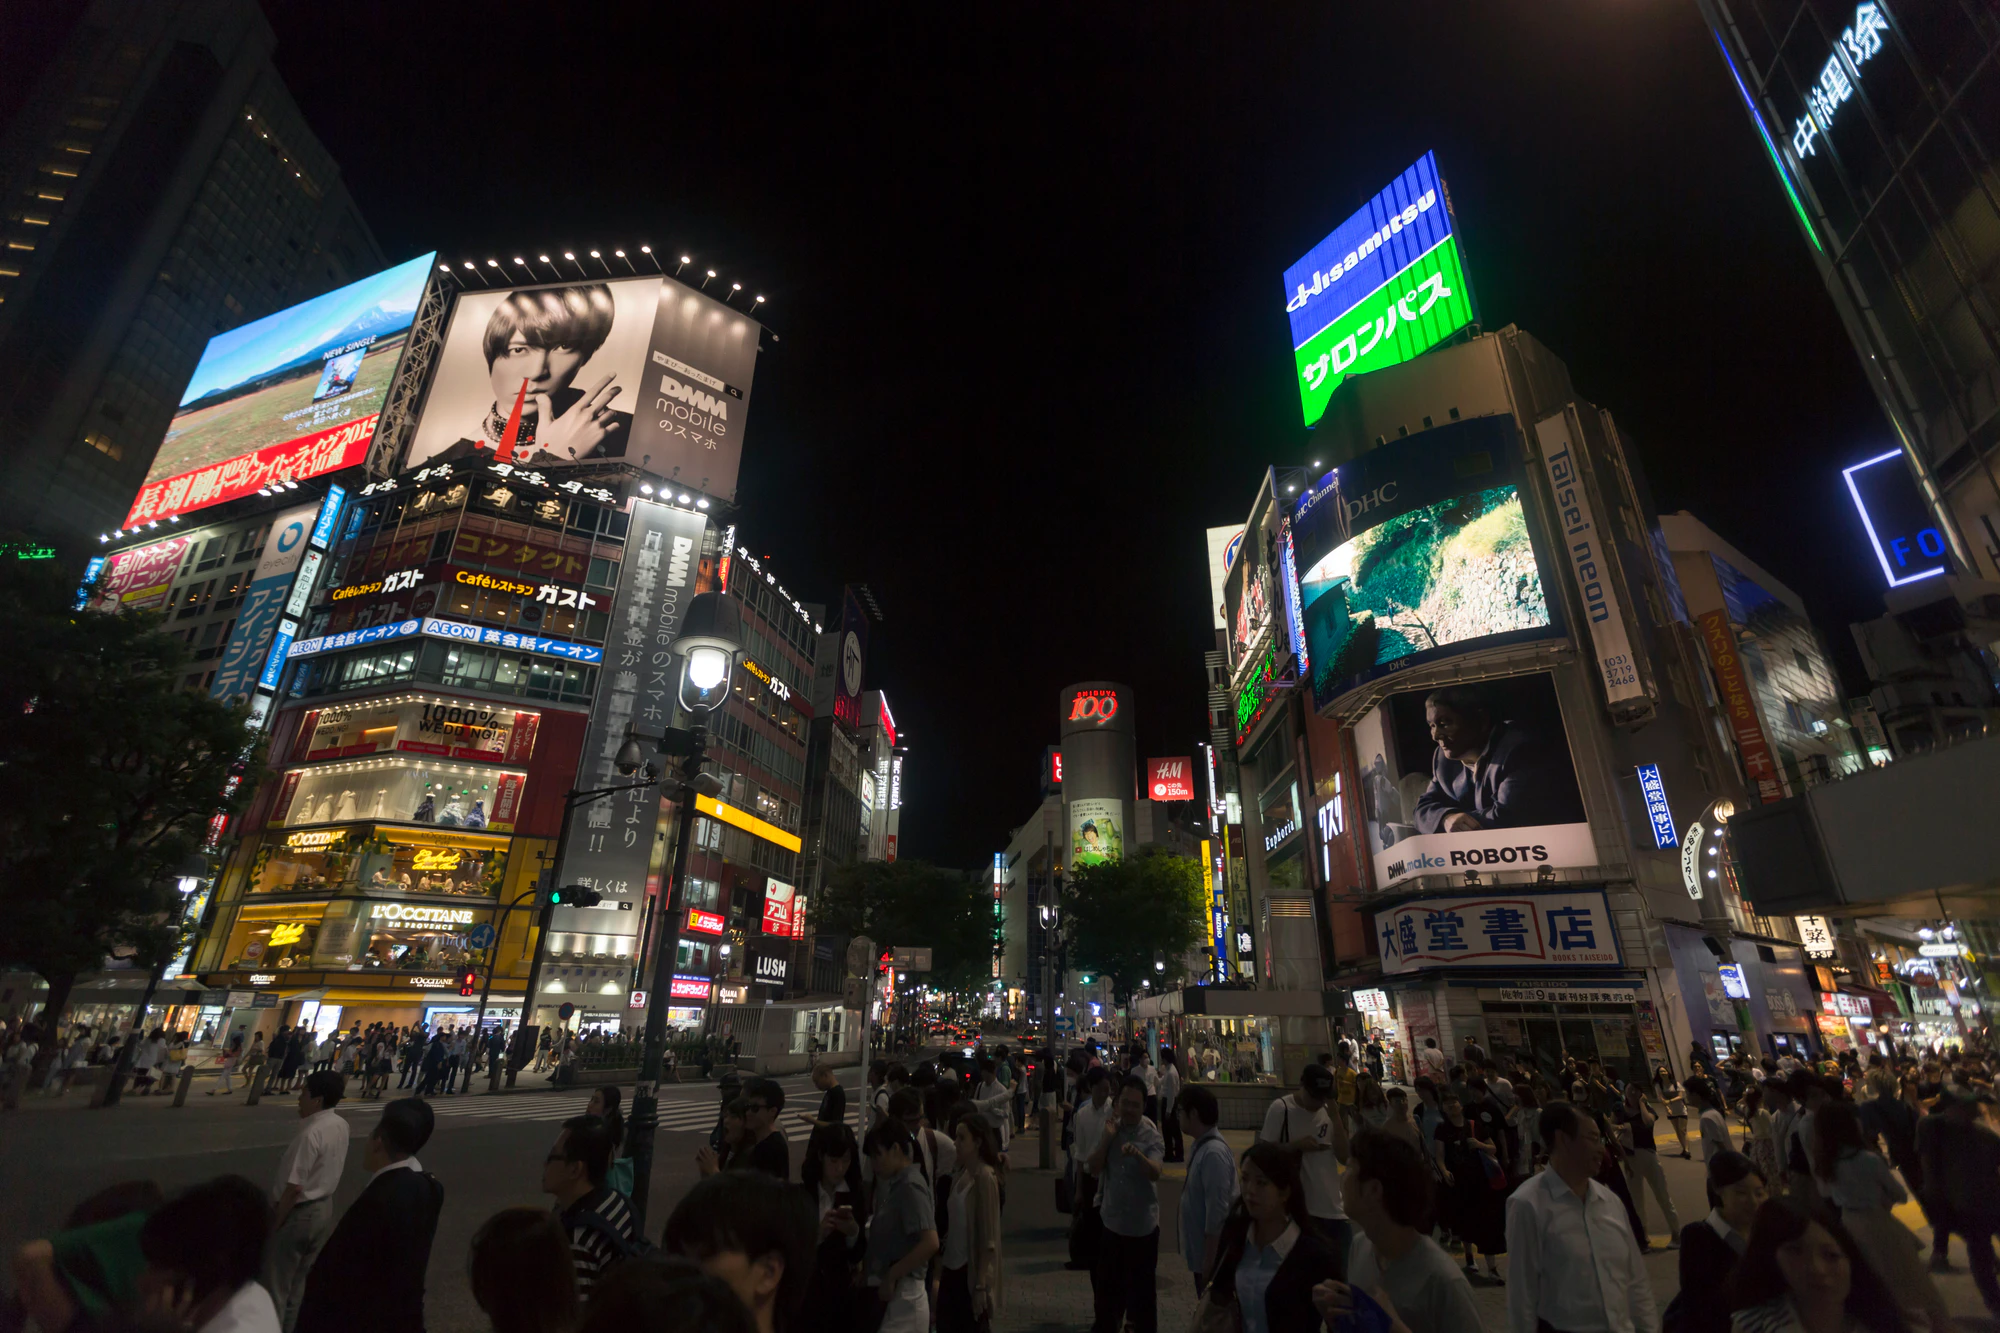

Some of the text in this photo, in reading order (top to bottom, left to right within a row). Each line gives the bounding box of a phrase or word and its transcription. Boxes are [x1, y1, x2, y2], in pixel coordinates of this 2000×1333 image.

[1302, 271, 1452, 391] サロンパス
[323, 335, 377, 360] NEW SINGLE
[660, 374, 727, 421] DMM
[656, 397, 726, 436] mobile
[659, 420, 717, 450] のスマホ
[1294, 476, 1339, 524] DHC Channel
[1348, 481, 1400, 522] DHC
[1548, 441, 1609, 624] Taisei neon
[263, 552, 299, 571] eyecity
[455, 531, 583, 574] コンタクト
[666, 535, 693, 588] DMM
[381, 568, 424, 594] ガスト
[537, 583, 596, 611] ガスト
[656, 587, 679, 646] mobile
[290, 639, 321, 655] AEON
[427, 620, 599, 661] AEON 英会話イーオン
[1388, 657, 1411, 672] DHC
[1604, 653, 1627, 668] (03)
[1605, 664, 1632, 678] 3719
[1706, 615, 1750, 719] クスリのことなら
[1608, 674, 1636, 688] 2468
[422, 703, 498, 729] 1000%
[1068, 696, 1119, 724] 109
[1156, 761, 1182, 780] H&M
[890, 760, 901, 810] BIC CAMERA
[1167, 788, 1188, 796] 150m
[1641, 769, 1675, 846] 大盛堂商事ビル
[1265, 819, 1295, 851] Euphoria
[1450, 845, 1548, 867] ROBOTS
[371, 903, 474, 924] L'OCCITANE
[767, 900, 787, 919] アコム
[388, 920, 454, 931] EN PROVENCE
[1215, 912, 1223, 938] MIZUHO
[1381, 906, 1598, 961] 大盛堂書店
[756, 956, 787, 978] LUSH
[1552, 953, 1614, 962] BOOKS TAISEIDO
[410, 977, 454, 985] L'OCCITANE
